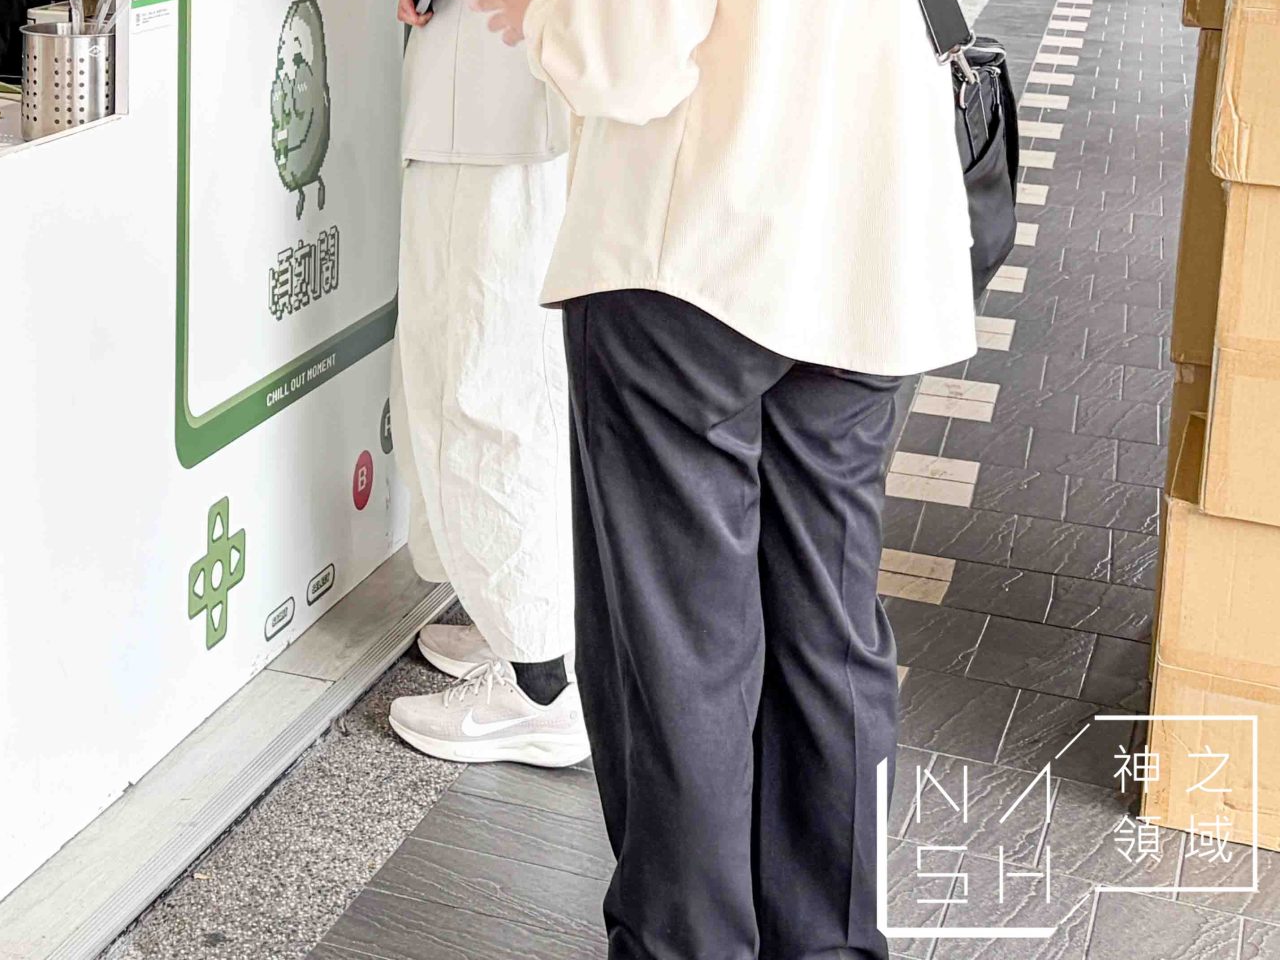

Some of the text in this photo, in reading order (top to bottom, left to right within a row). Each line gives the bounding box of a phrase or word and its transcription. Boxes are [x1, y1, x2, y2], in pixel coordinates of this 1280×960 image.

[268, 224, 339, 321] 頃刻間
[266, 353, 336, 407] CHILL OUT MOMENT
[358, 465, 367, 492] B
